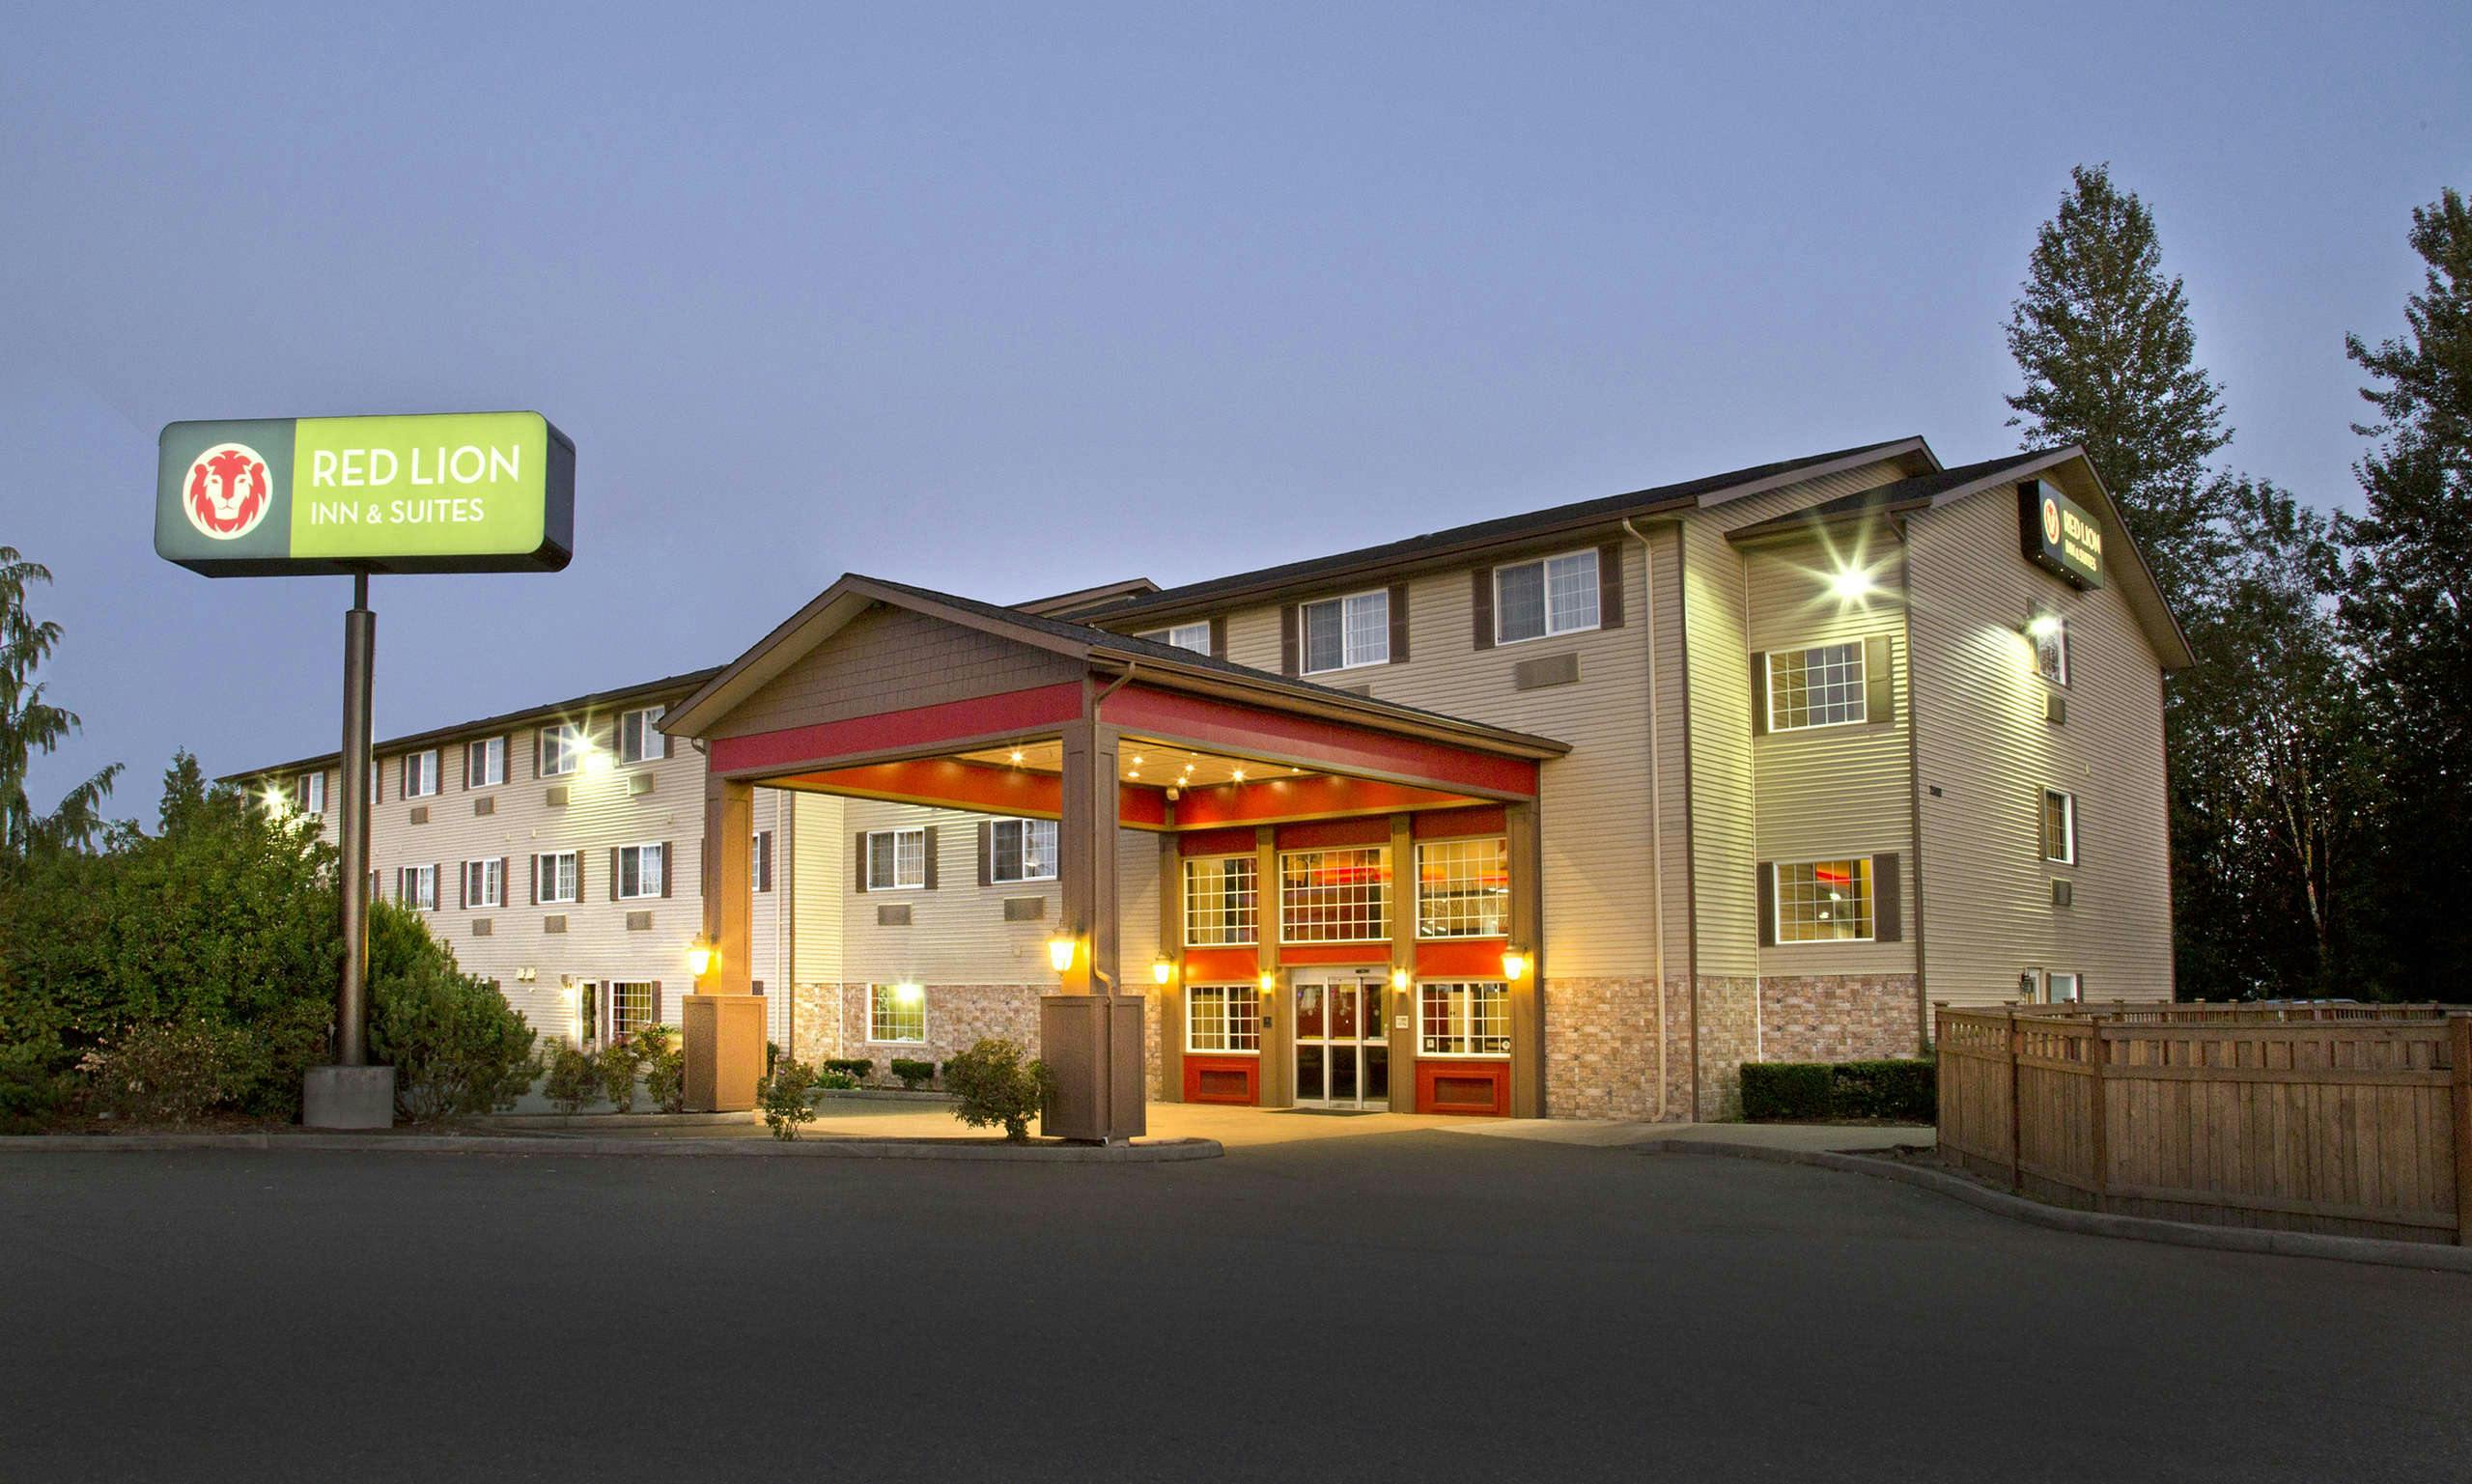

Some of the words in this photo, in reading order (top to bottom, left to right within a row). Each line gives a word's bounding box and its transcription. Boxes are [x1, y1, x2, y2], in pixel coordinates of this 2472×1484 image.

[313, 449, 399, 487] RED
[412, 445, 520, 486] LION
[312, 502, 358, 524] INN
[367, 504, 382, 523] &
[390, 498, 485, 524] SUITES
[2064, 510, 2081, 541] RED
[2081, 521, 2101, 555] LION
